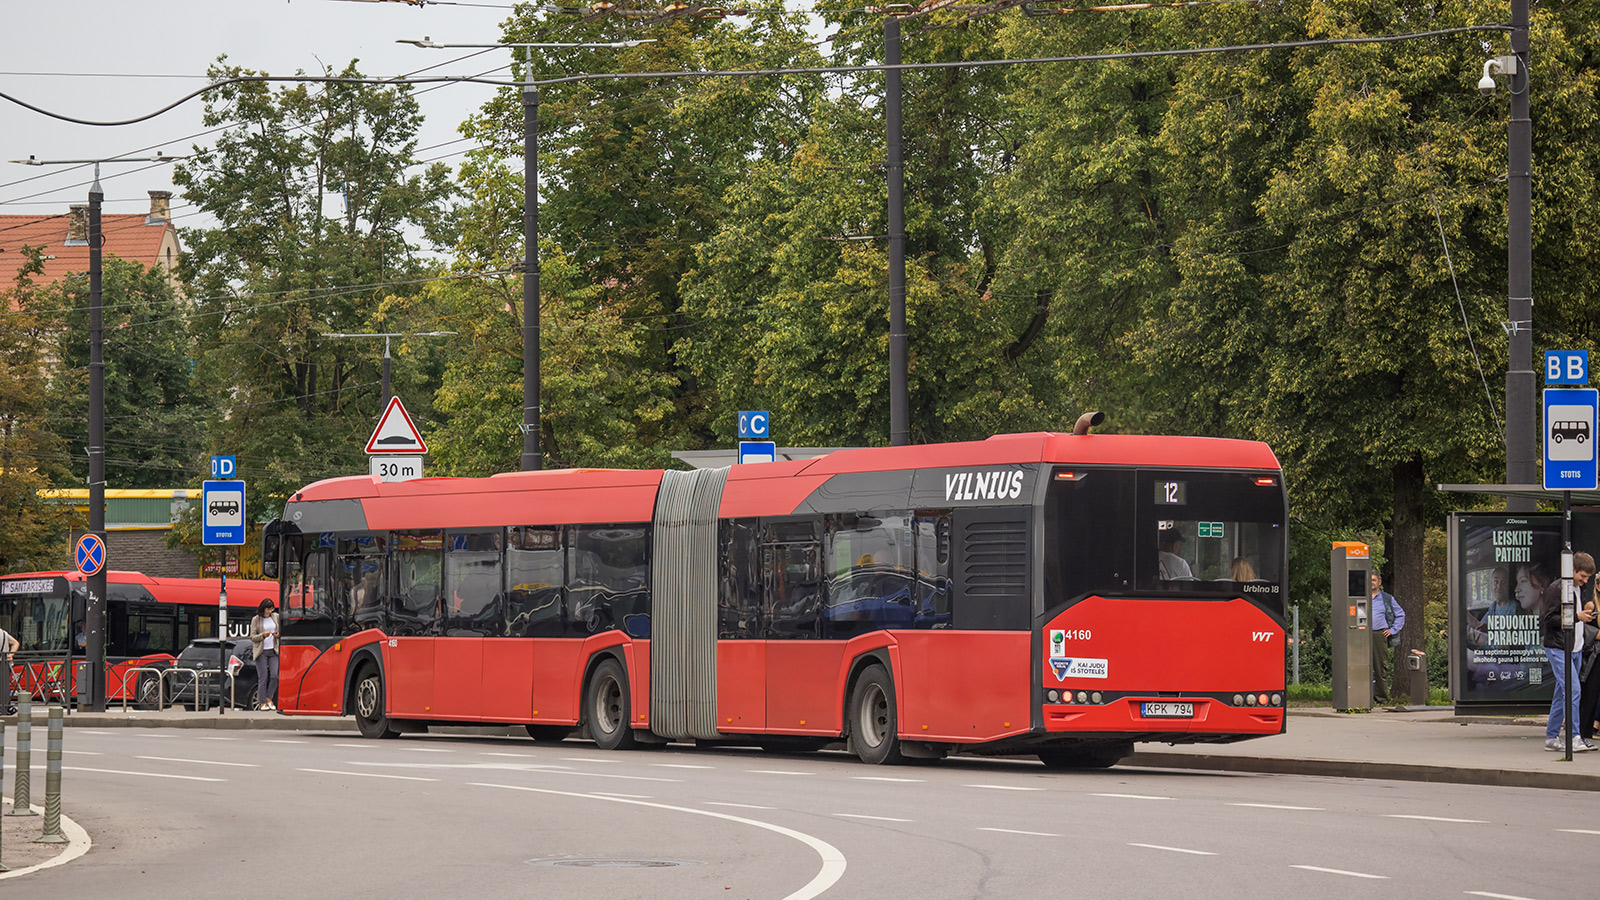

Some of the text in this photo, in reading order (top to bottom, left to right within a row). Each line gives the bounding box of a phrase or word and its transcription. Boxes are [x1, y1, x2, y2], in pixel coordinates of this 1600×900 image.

[1548, 355, 1584, 380] B B
[750, 414, 766, 434] C
[221, 459, 233, 474] D
[380, 463, 414, 477] 30 m
[1560, 470, 1581, 479] STOTIS
[945, 470, 1024, 501] VILNIUS
[1164, 482, 1178, 503] 12
[1492, 530, 1533, 546] LEISKITE
[1495, 547, 1531, 562] PATIRTI
[1243, 585, 1279, 593] Urbino 18
[1487, 614, 1540, 630] NEDUOKITE
[1066, 630, 1092, 640] 4160
[1252, 631, 1274, 642] VVT
[1487, 630, 1540, 646] PARAGAUTI
[1147, 704, 1192, 715] KPK 794
